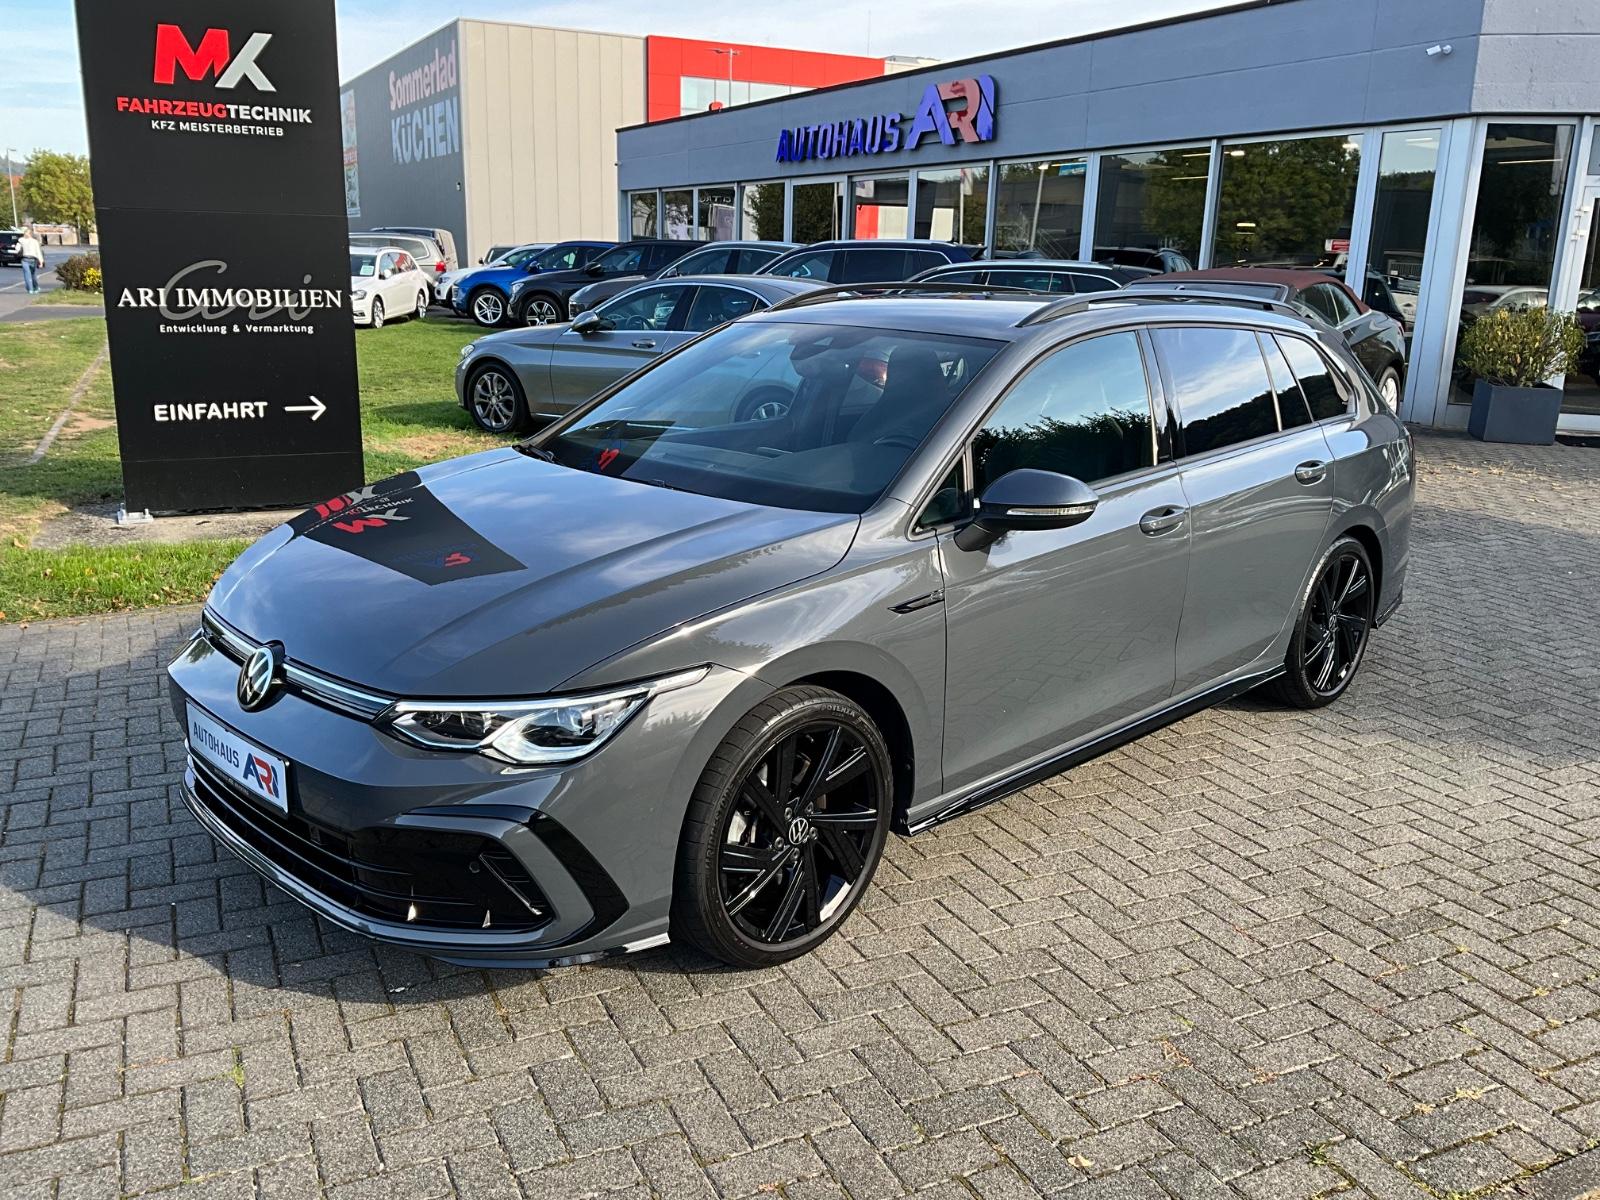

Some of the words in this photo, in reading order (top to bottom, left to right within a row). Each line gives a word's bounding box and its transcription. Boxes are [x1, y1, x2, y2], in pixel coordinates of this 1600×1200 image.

[154, 24, 277, 92] MK
[389, 39, 457, 111] Sommerlad
[116, 97, 312, 123] FAHRZEUGTECHNIK
[776, 112, 902, 163] AUTOHAUS
[903, 73, 996, 150] ARI
[151, 120, 176, 131] KFZ
[179, 121, 284, 136] MEISTERBETRIEB
[117, 288, 167, 307] ARI
[176, 288, 342, 308] IMMOBILIEN
[160, 324, 227, 335] Entwicklung
[232, 324, 240, 333] &
[245, 324, 314, 335] Vermarktung
[153, 402, 268, 421] EINFAHRT
[193, 721, 240, 769] AUTOHAUS
[242, 752, 280, 799] ARI
